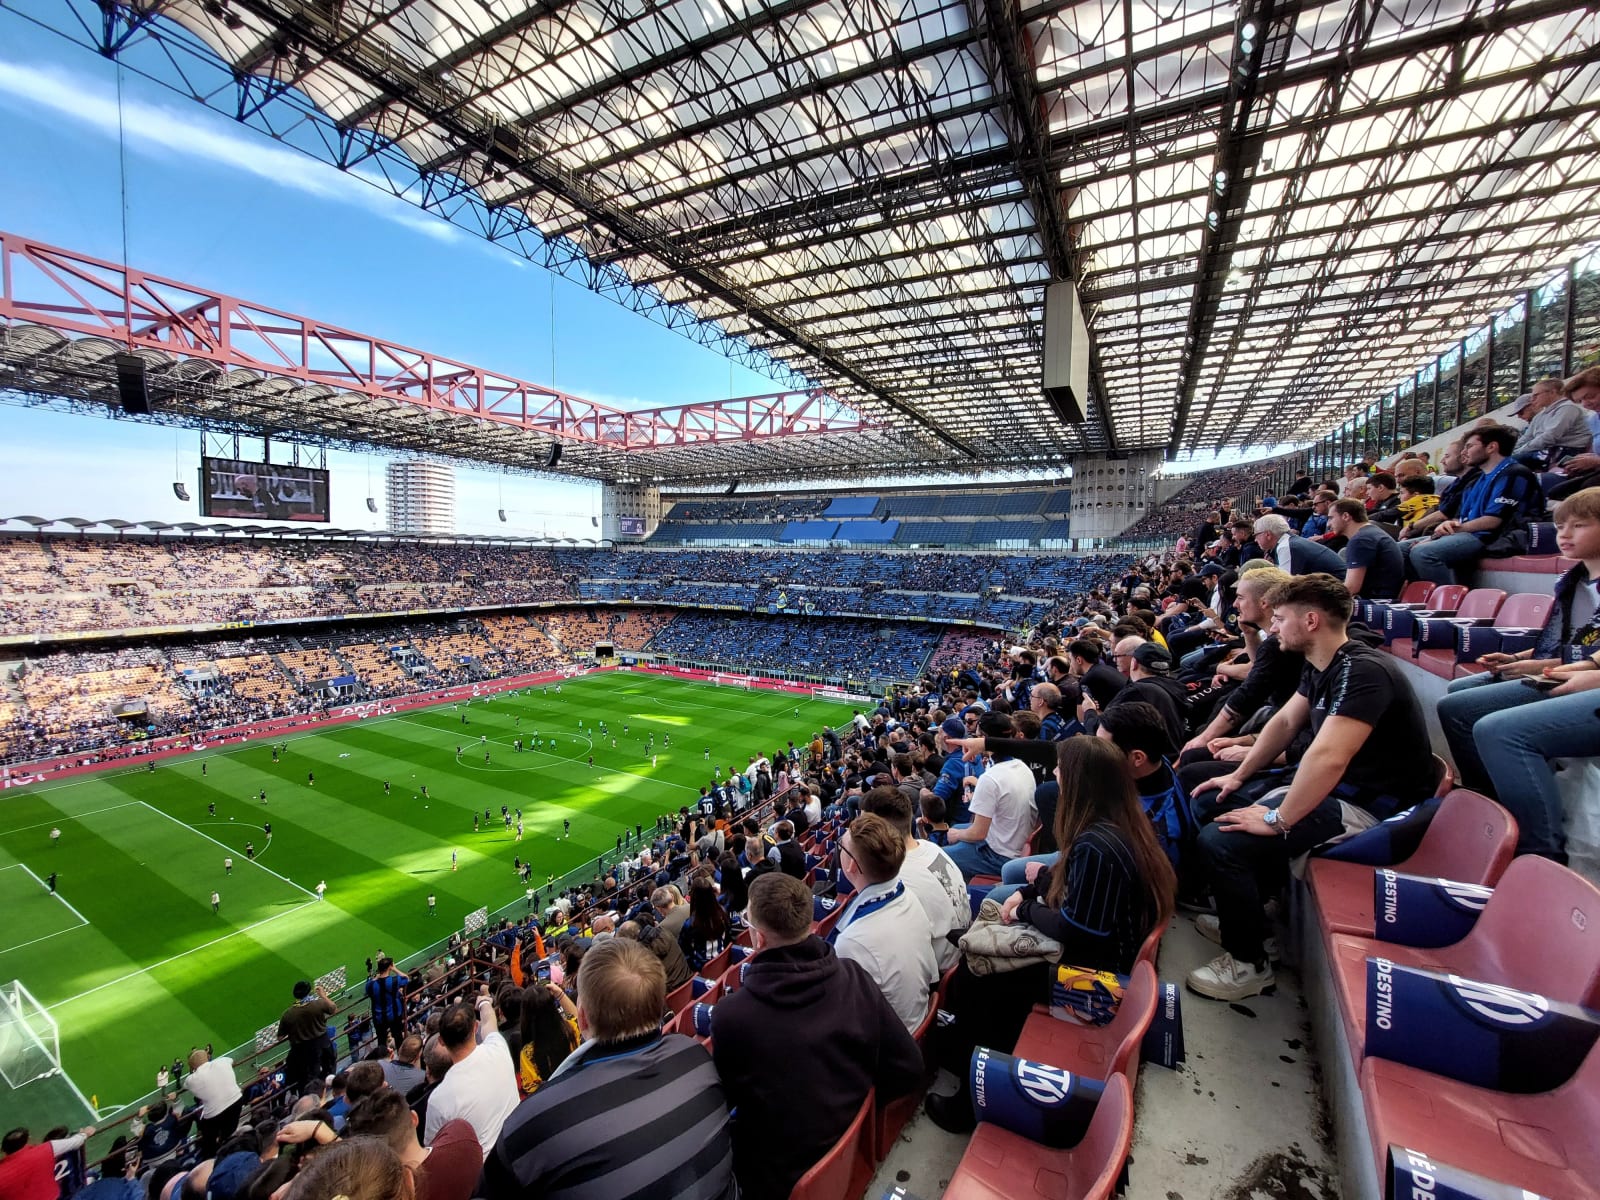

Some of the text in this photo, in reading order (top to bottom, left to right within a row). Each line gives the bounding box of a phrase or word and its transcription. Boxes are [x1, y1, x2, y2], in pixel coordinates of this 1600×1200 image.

[1494, 496, 1519, 507] ebay
[702, 802, 713, 814] 10
[1384, 873, 1398, 924] DESTINO
[1376, 961, 1393, 1030] DESTINO
[975, 1060, 987, 1107] DESTINO
